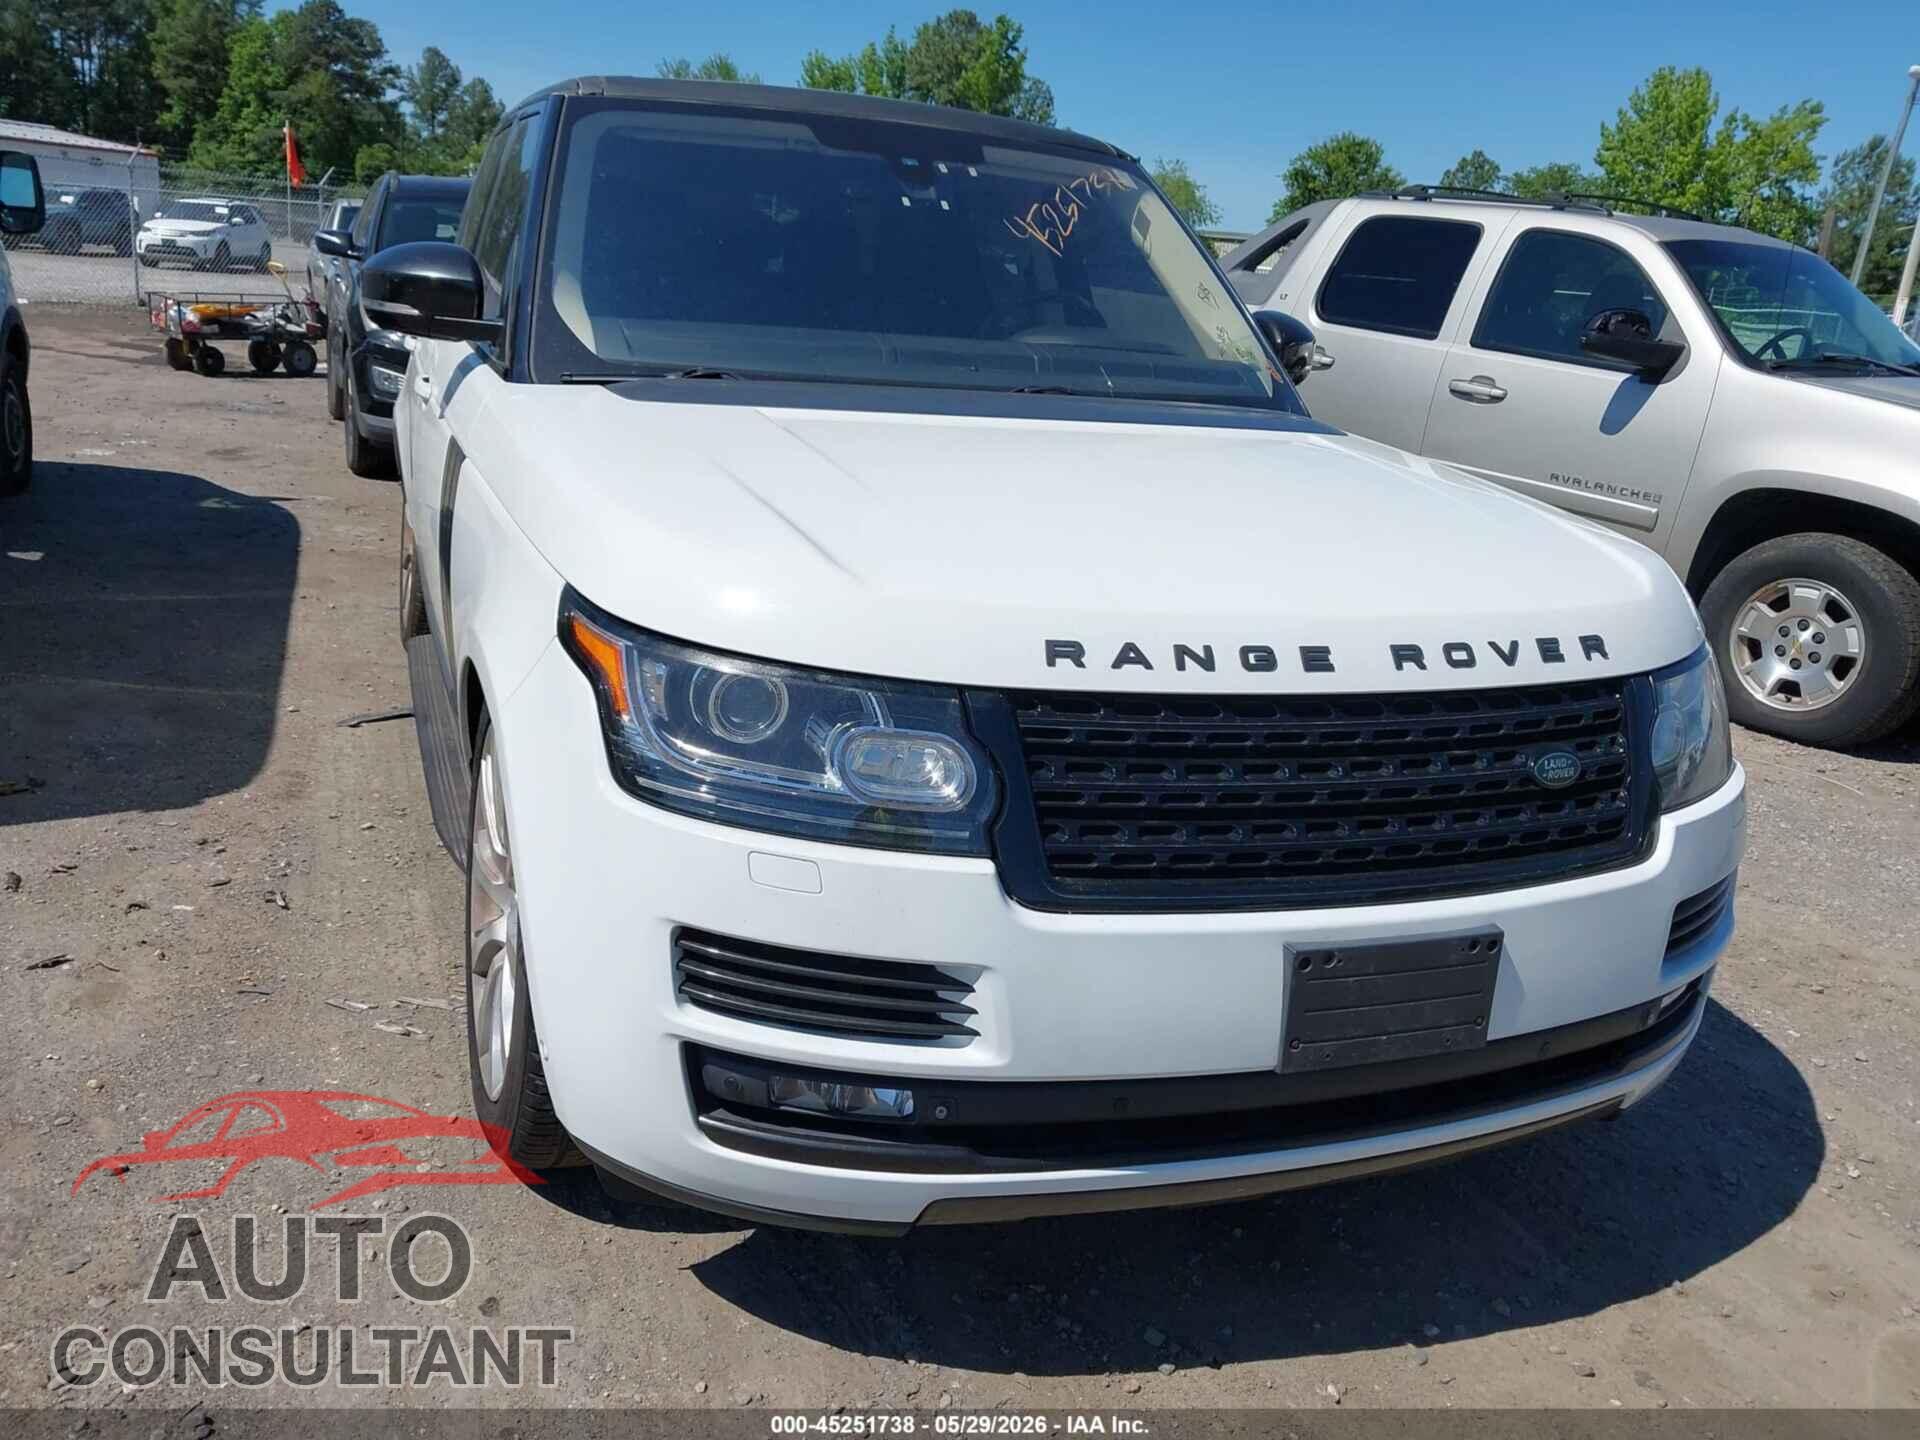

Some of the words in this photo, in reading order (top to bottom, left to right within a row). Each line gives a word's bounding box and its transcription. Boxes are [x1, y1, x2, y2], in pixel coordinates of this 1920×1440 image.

[1549, 472, 1652, 502] AVALANCHE
[1045, 639, 1336, 673] RANGE
[1389, 634, 1610, 671] ROVER
